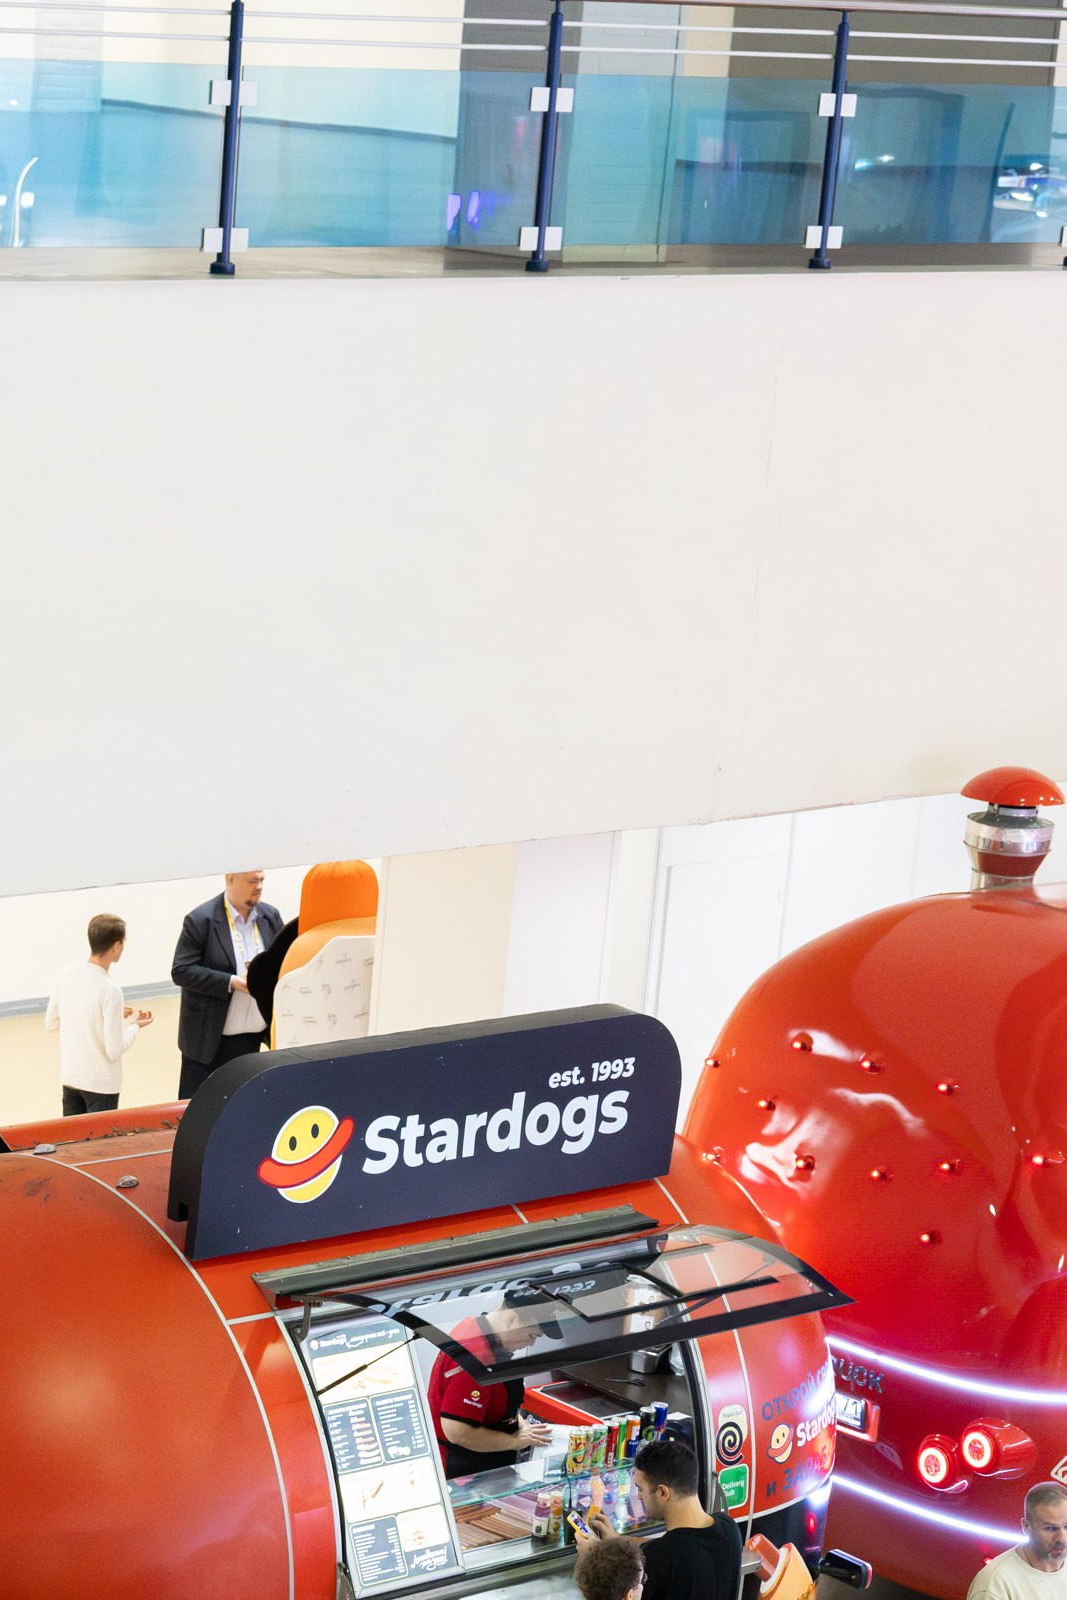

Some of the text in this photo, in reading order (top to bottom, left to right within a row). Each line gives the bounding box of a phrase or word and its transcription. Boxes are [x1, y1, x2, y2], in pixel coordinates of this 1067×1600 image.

[548, 1056, 636, 1090] est. 1993
[361, 1087, 631, 1176] Stardogs
[721, 1479, 745, 1490] Delivery
